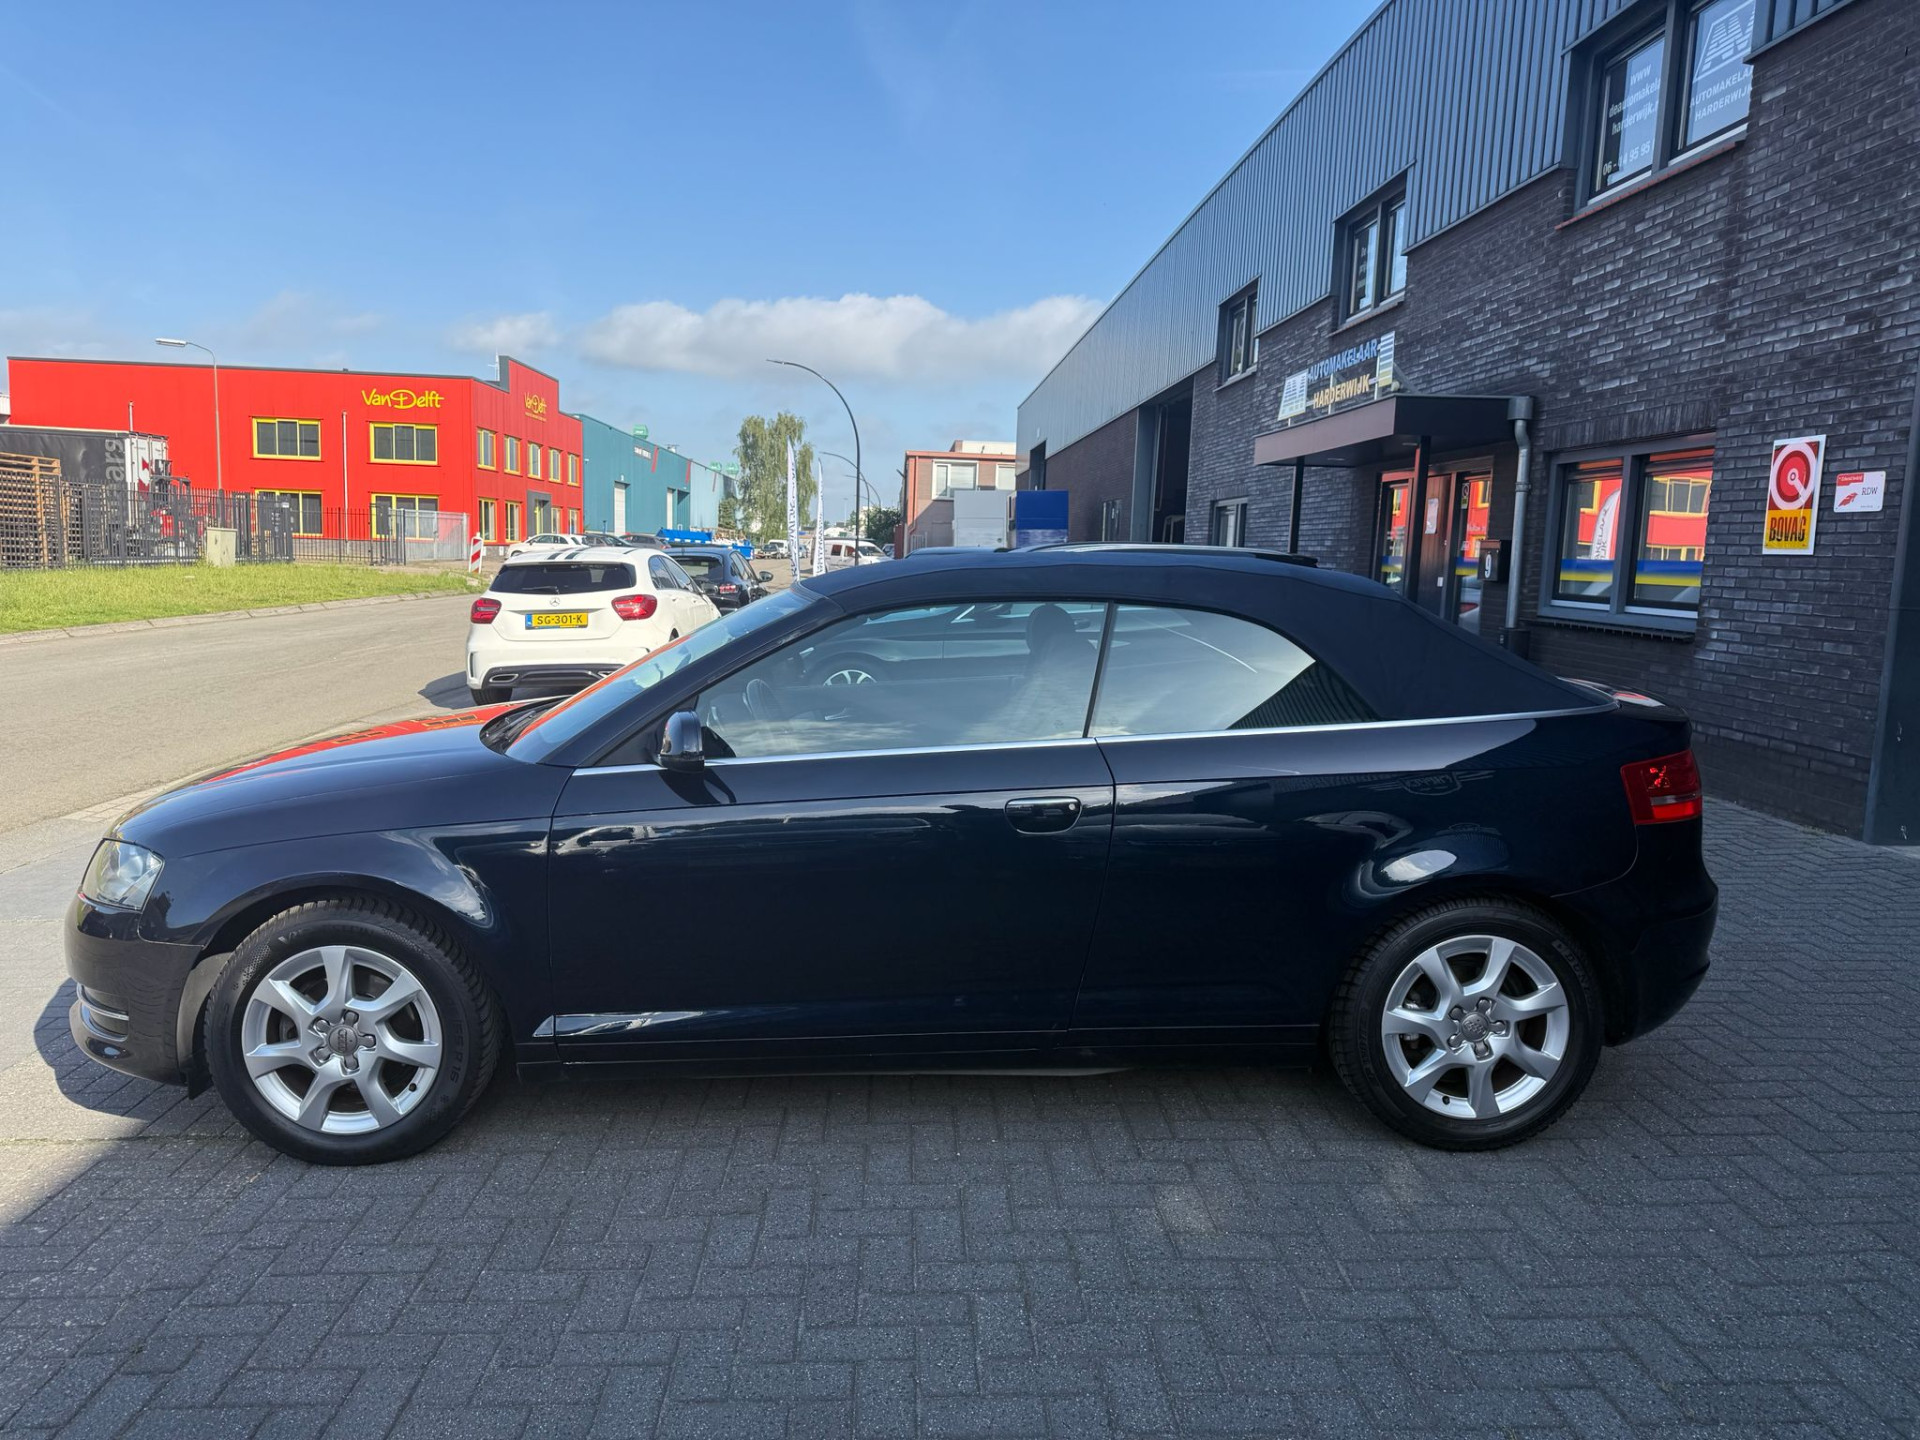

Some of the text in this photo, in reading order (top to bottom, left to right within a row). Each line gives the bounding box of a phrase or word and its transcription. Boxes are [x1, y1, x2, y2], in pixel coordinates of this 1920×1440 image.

[1308, 338, 1378, 382] AUTOMAKELAAR
[1313, 374, 1370, 409] HARDERWIJK
[1861, 486, 1878, 496] RDW
[1768, 515, 1807, 542] BOVAG
[1485, 553, 1492, 578] 9
[537, 614, 583, 625] SG-301-K
